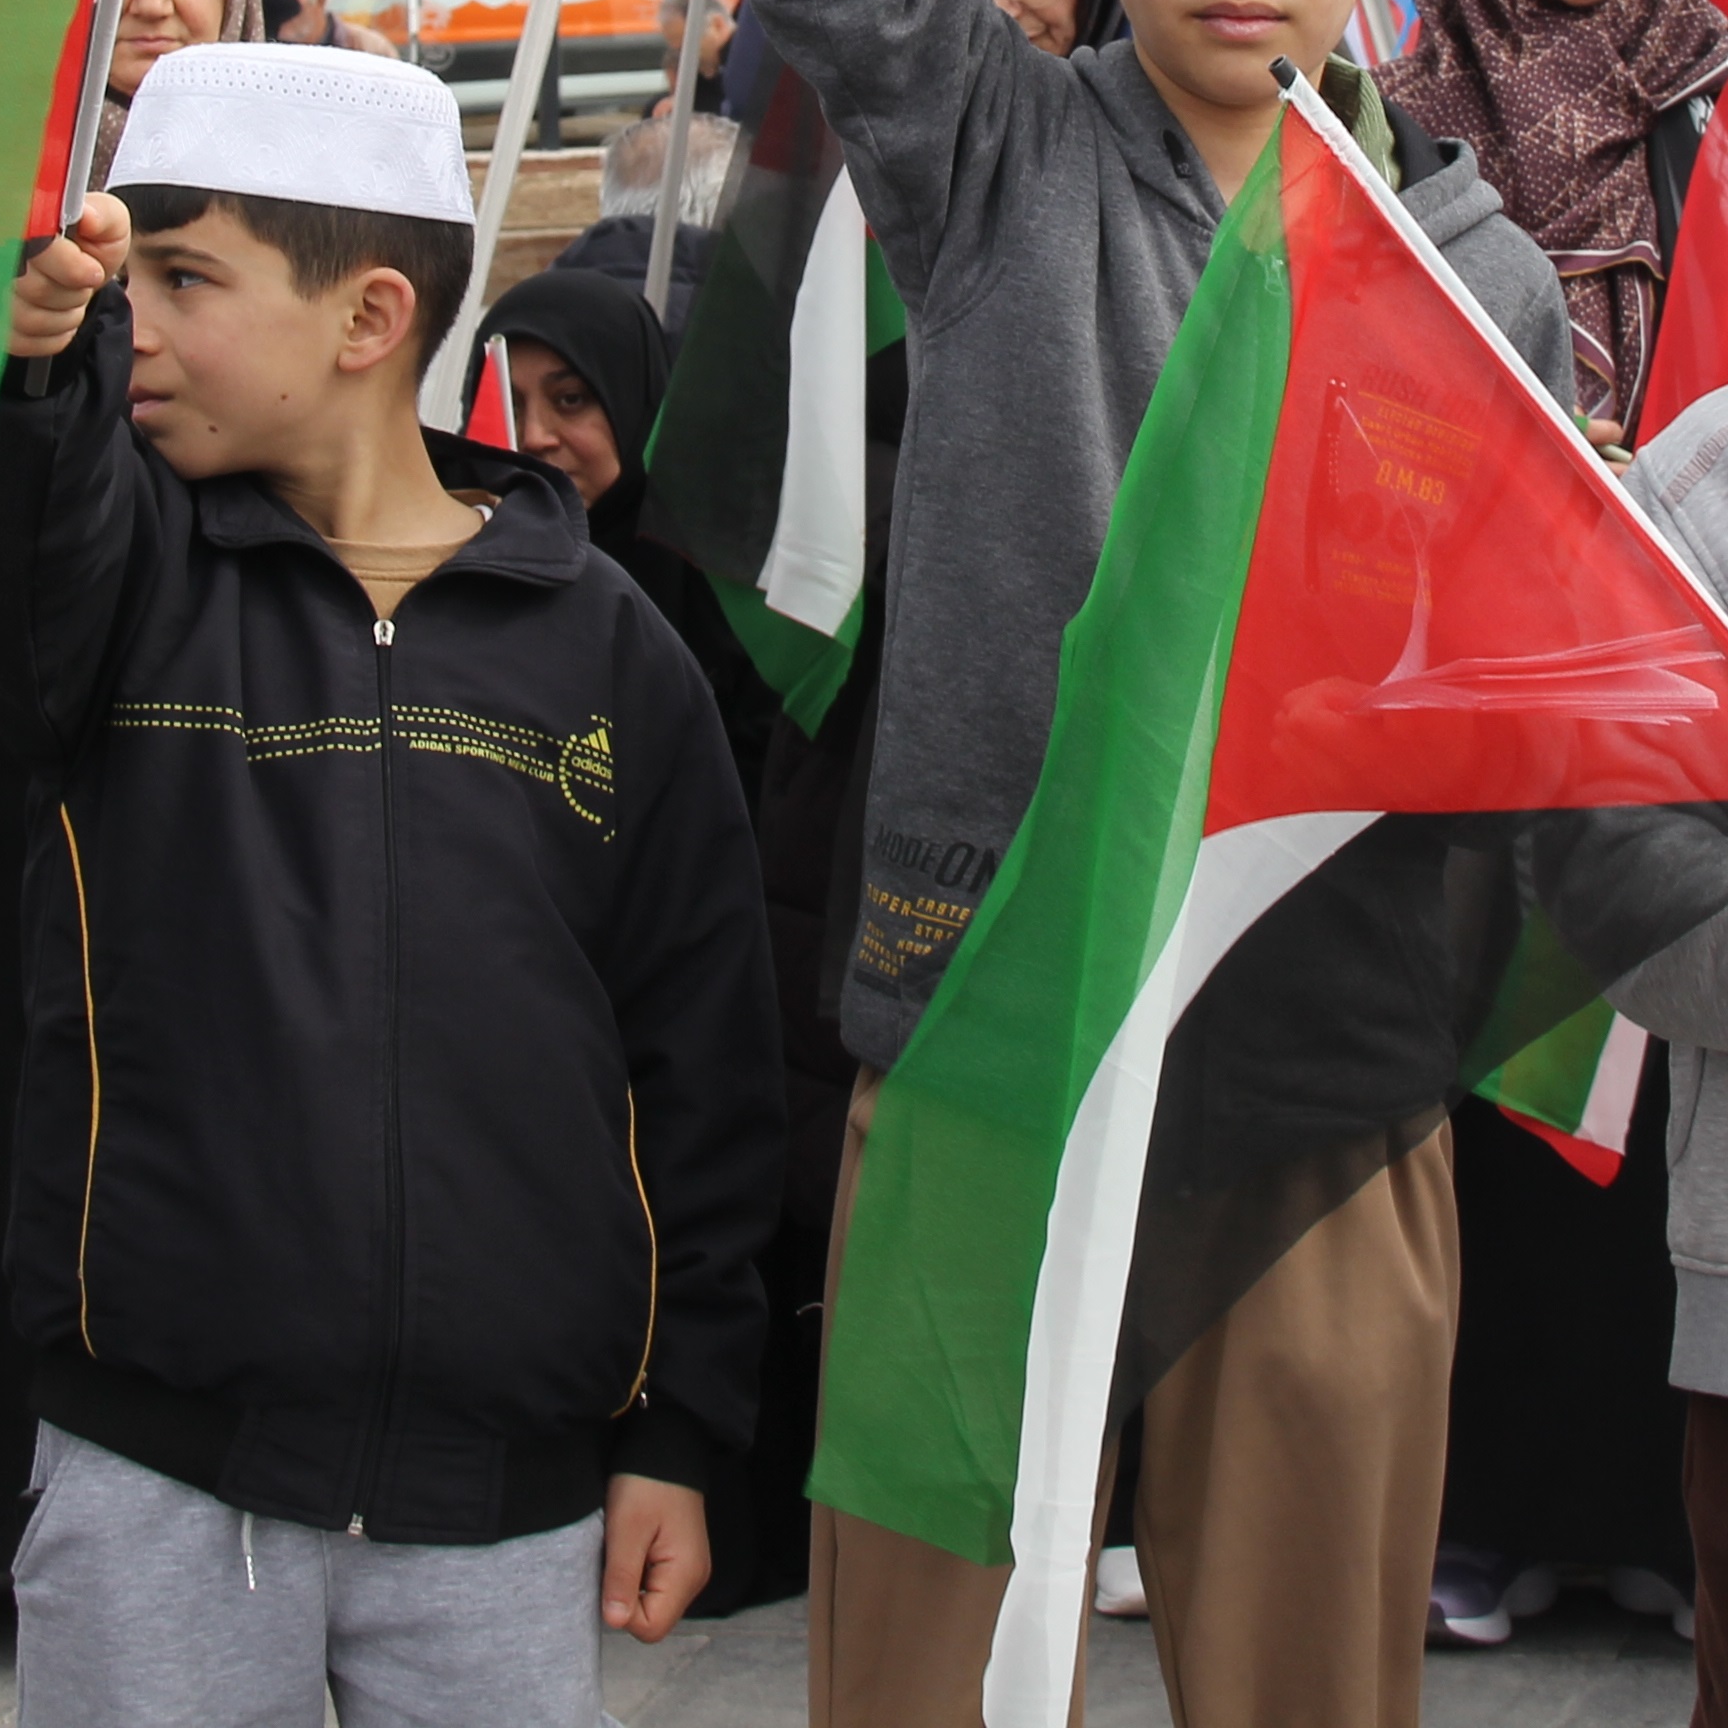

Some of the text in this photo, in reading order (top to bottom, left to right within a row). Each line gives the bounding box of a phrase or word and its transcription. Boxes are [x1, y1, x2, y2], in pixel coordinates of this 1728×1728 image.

[409, 739, 452, 753] ADIDAS
[455, 744, 506, 765] SPORTING
[528, 766, 554, 783] CLUB
[571, 755, 613, 780] adidas
[916, 897, 971, 922] FASTE
